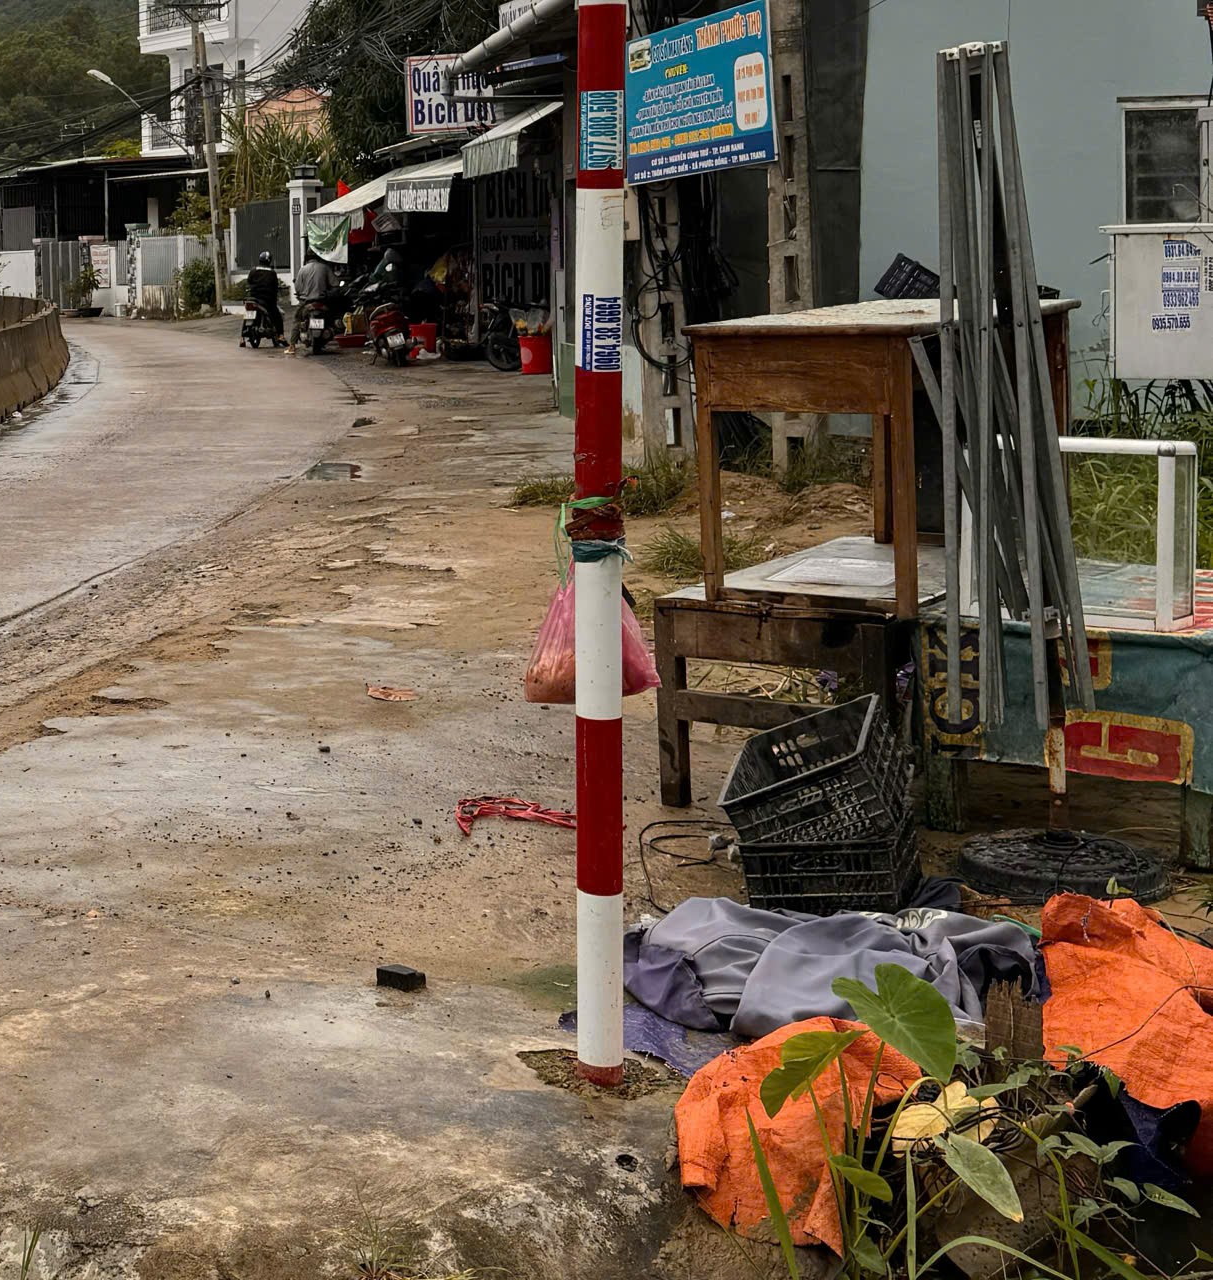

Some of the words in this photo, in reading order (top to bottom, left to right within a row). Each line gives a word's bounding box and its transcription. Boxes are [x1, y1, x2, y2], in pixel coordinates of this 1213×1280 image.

[414, 98, 458, 125] Bích
[589, 91, 618, 168] 0977.808.508
[594, 297, 621, 370] 0964.38.6664
